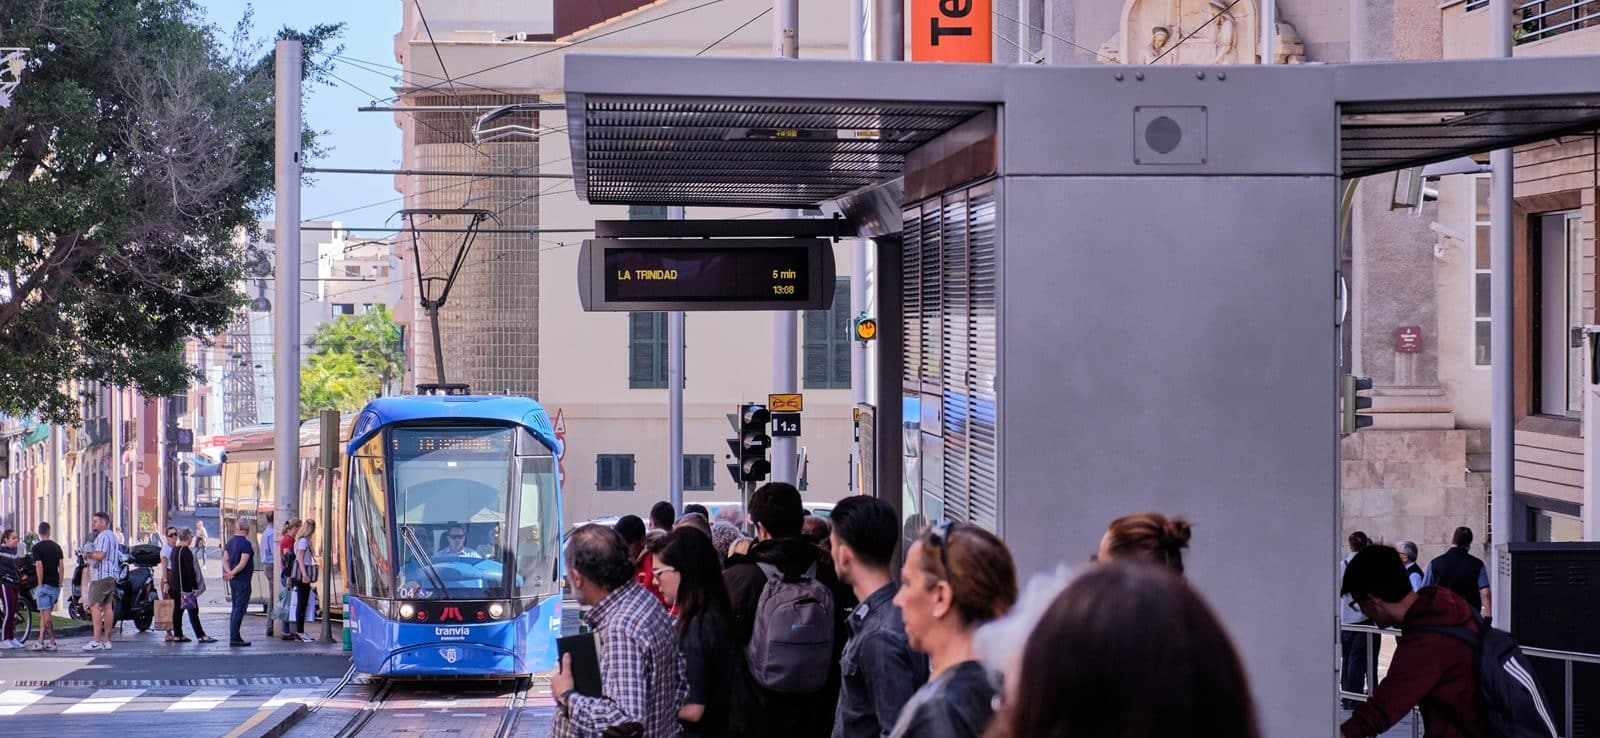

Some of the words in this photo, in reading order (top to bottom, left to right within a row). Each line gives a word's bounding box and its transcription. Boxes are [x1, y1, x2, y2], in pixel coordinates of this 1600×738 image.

[930, 0, 973, 46] Te
[617, 270, 631, 280] LA
[635, 269, 678, 280] TRINIDAD
[780, 268, 796, 279] min
[772, 285, 795, 295] 13:08
